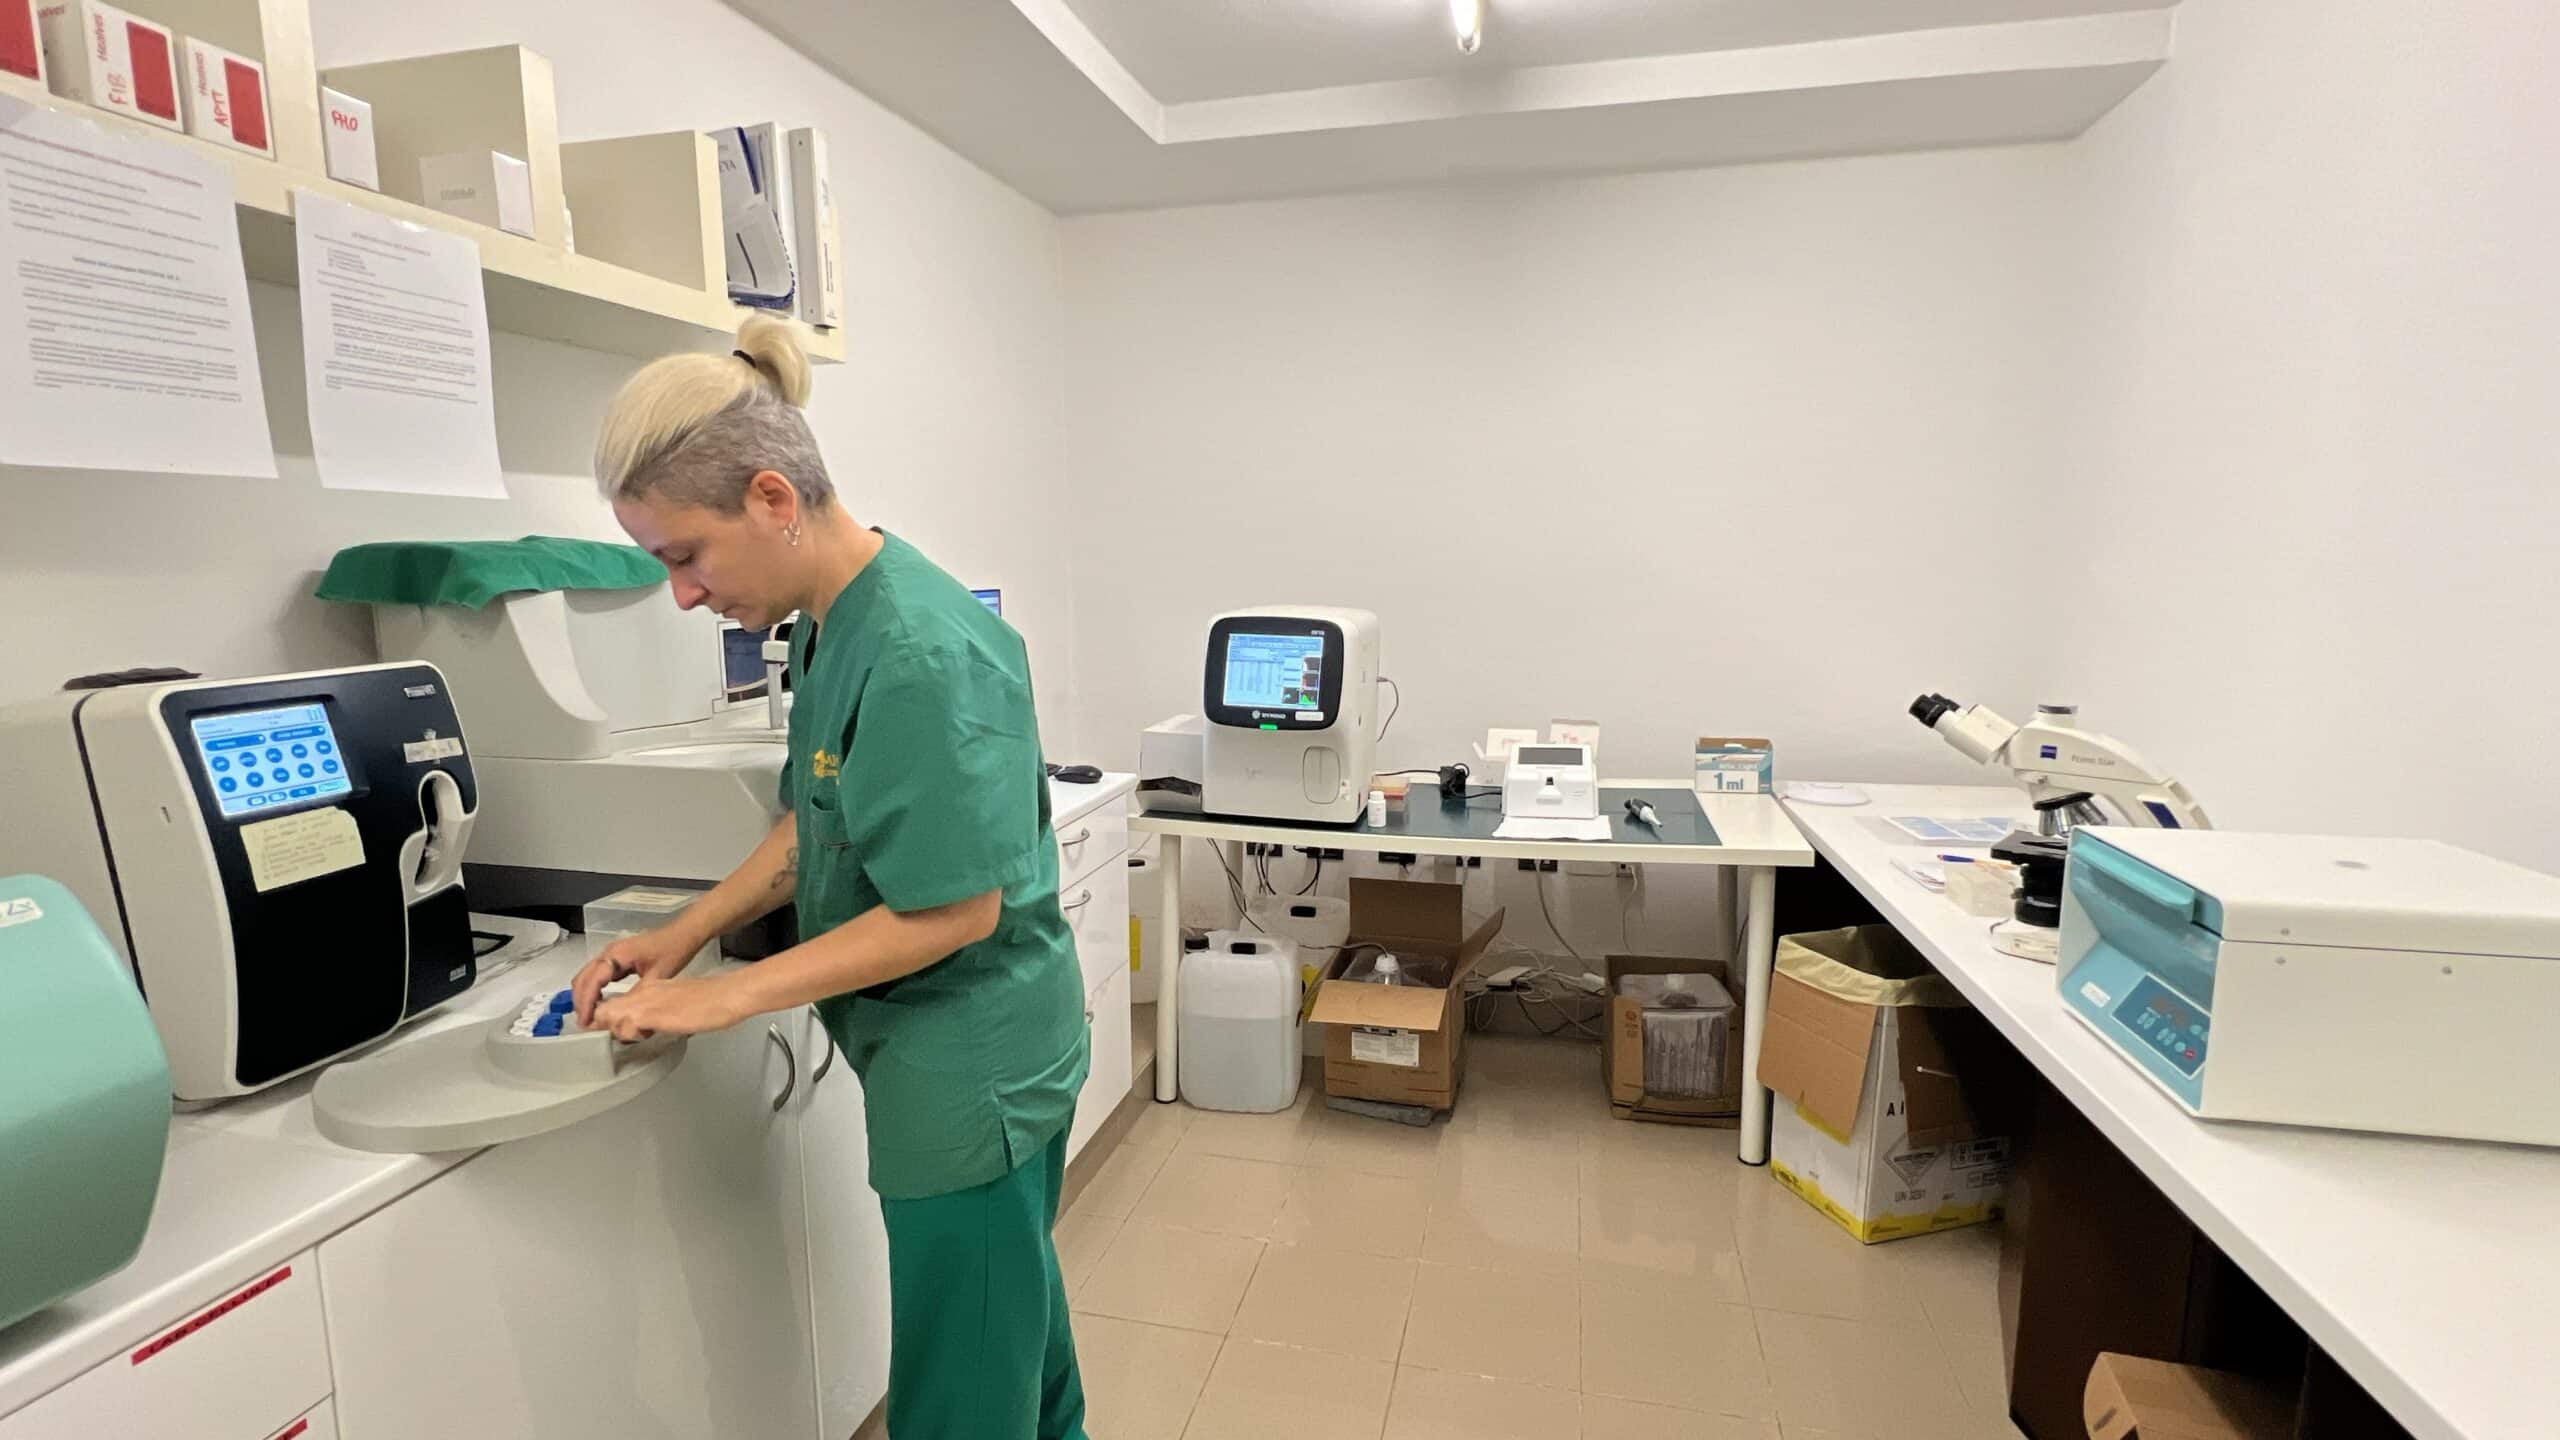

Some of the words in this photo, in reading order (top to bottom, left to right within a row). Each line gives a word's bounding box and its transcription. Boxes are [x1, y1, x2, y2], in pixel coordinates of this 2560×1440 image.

[211, 88, 229, 127] APTT
[1713, 772, 1724, 791] 1
[1726, 778, 1744, 791] ml
